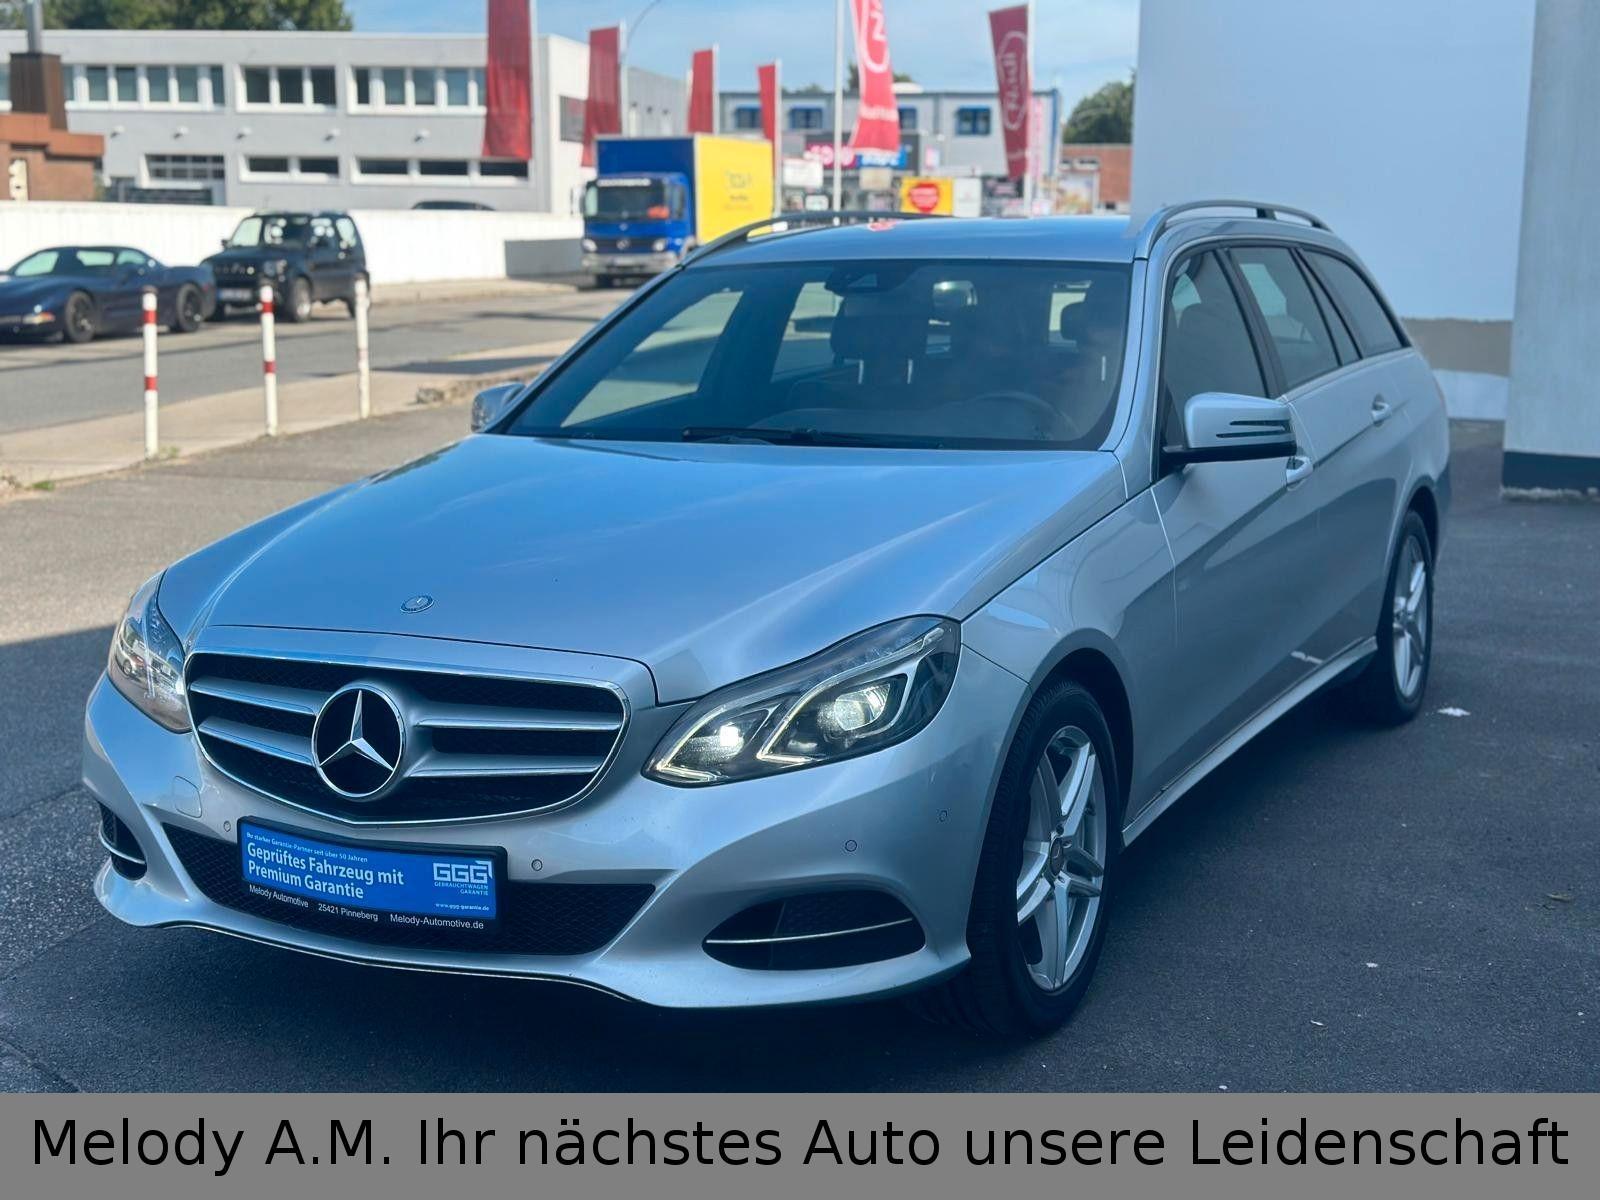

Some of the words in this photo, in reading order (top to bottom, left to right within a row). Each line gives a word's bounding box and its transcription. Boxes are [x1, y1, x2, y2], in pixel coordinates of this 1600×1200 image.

[254, 835, 271, 845] starker
[271, 838, 313, 854] Garantie-Partner
[314, 849, 324, 857] seit
[324, 851, 338, 859] über
[347, 853, 368, 863] Jahren
[247, 842, 306, 870] Geprüftes
[309, 857, 374, 886] Fahrzeug
[378, 869, 404, 885] mit
[433, 861, 489, 884] GGG
[248, 860, 302, 887] Premium
[304, 874, 364, 899] Garantie
[434, 881, 489, 890] GEBRAUCHTWAGEN
[460, 888, 489, 896] GARANTIE
[249, 884, 272, 899] Melody
[272, 891, 309, 908] Automotive
[318, 903, 339, 915] 25421
[340, 907, 379, 922] Pinneberg
[390, 913, 484, 930] Melody-Automotive.de
[435, 903, 490, 911] www.ggg-garantie.de
